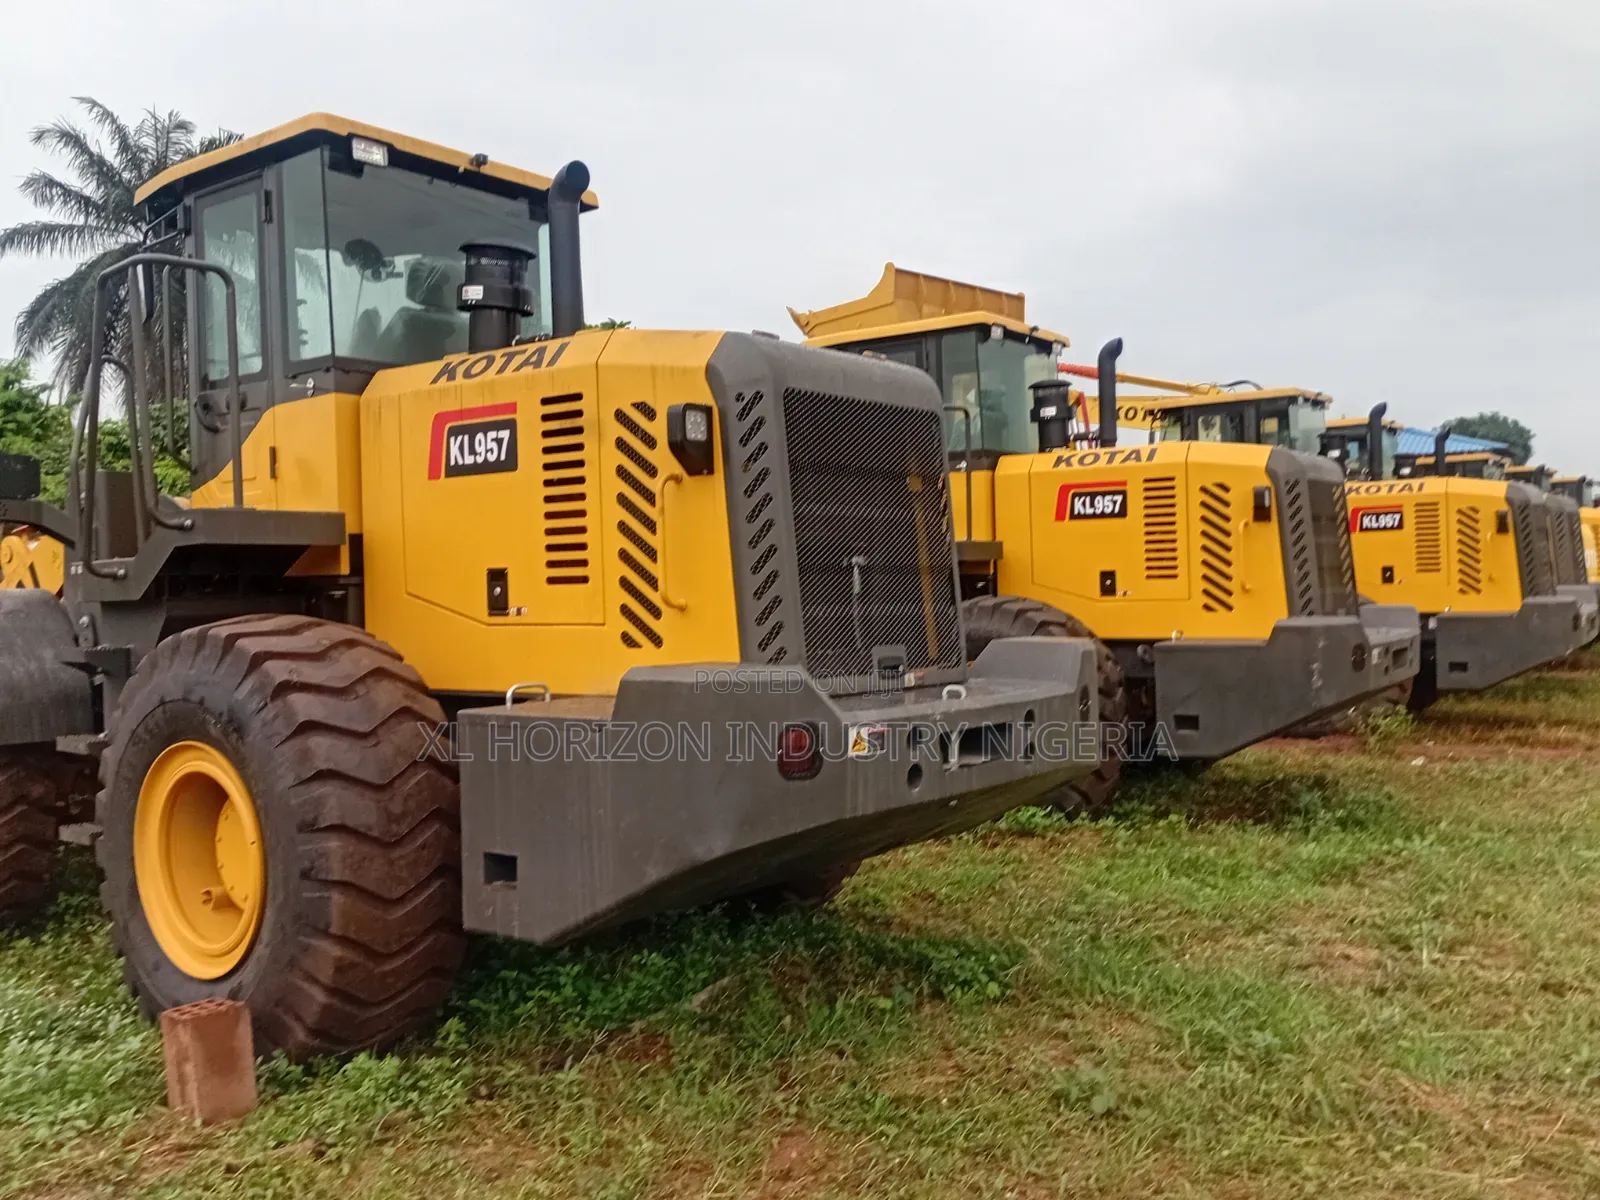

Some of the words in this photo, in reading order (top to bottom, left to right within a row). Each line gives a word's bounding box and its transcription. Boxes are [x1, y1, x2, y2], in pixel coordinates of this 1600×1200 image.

[428, 341, 571, 385] KOTAI
[449, 429, 511, 467] KL957
[1052, 447, 1158, 469] KOTAI
[1346, 482, 1425, 495] KOTAI
[1073, 494, 1123, 516] KL957
[1362, 512, 1402, 529] KL957
